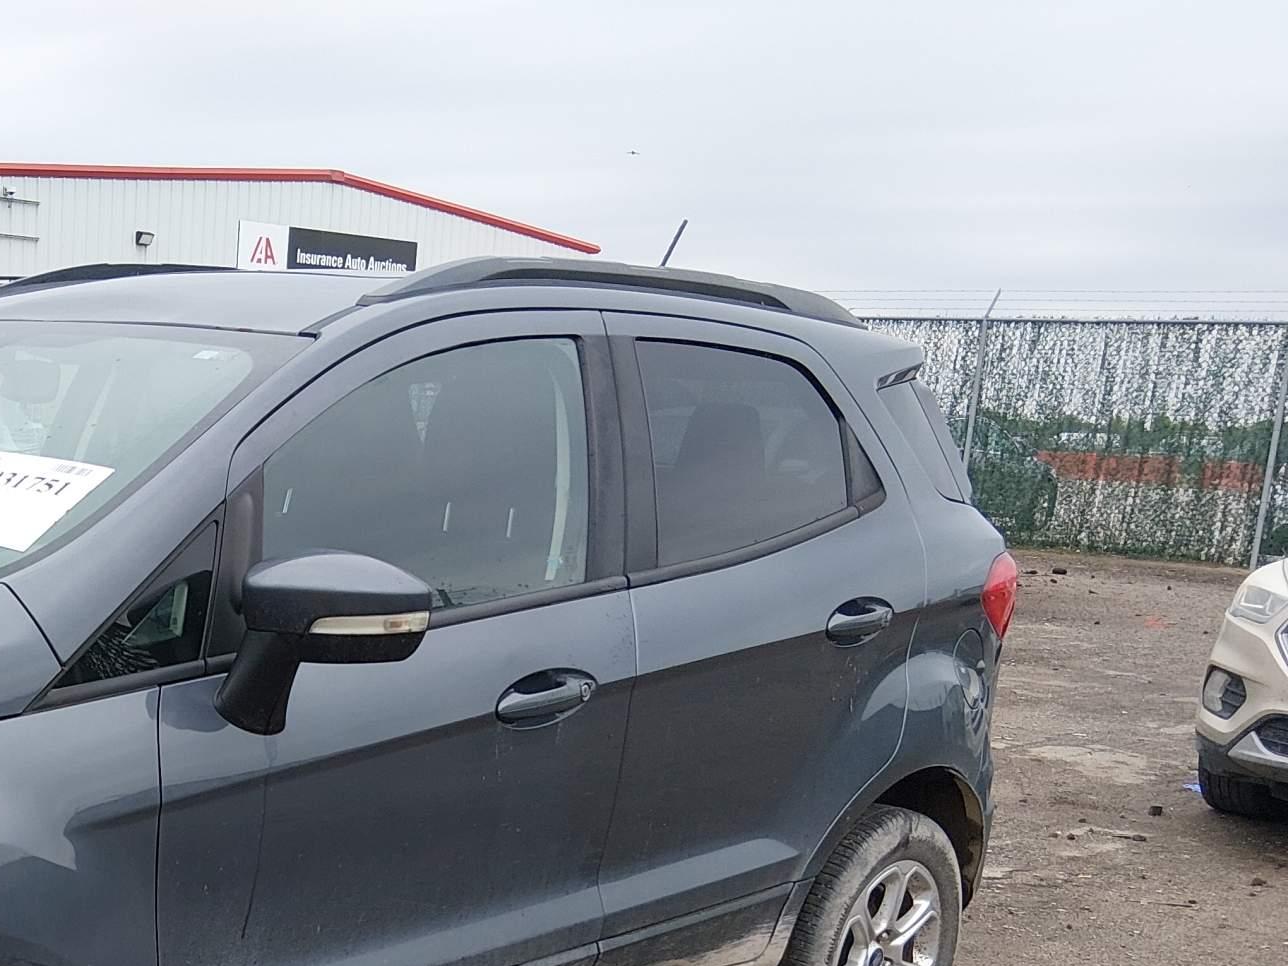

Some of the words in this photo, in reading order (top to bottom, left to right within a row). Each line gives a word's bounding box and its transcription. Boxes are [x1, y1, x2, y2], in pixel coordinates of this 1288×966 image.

[296, 248, 343, 268] Insurance
[344, 254, 366, 271] Auto
[368, 256, 408, 272] Auctions
